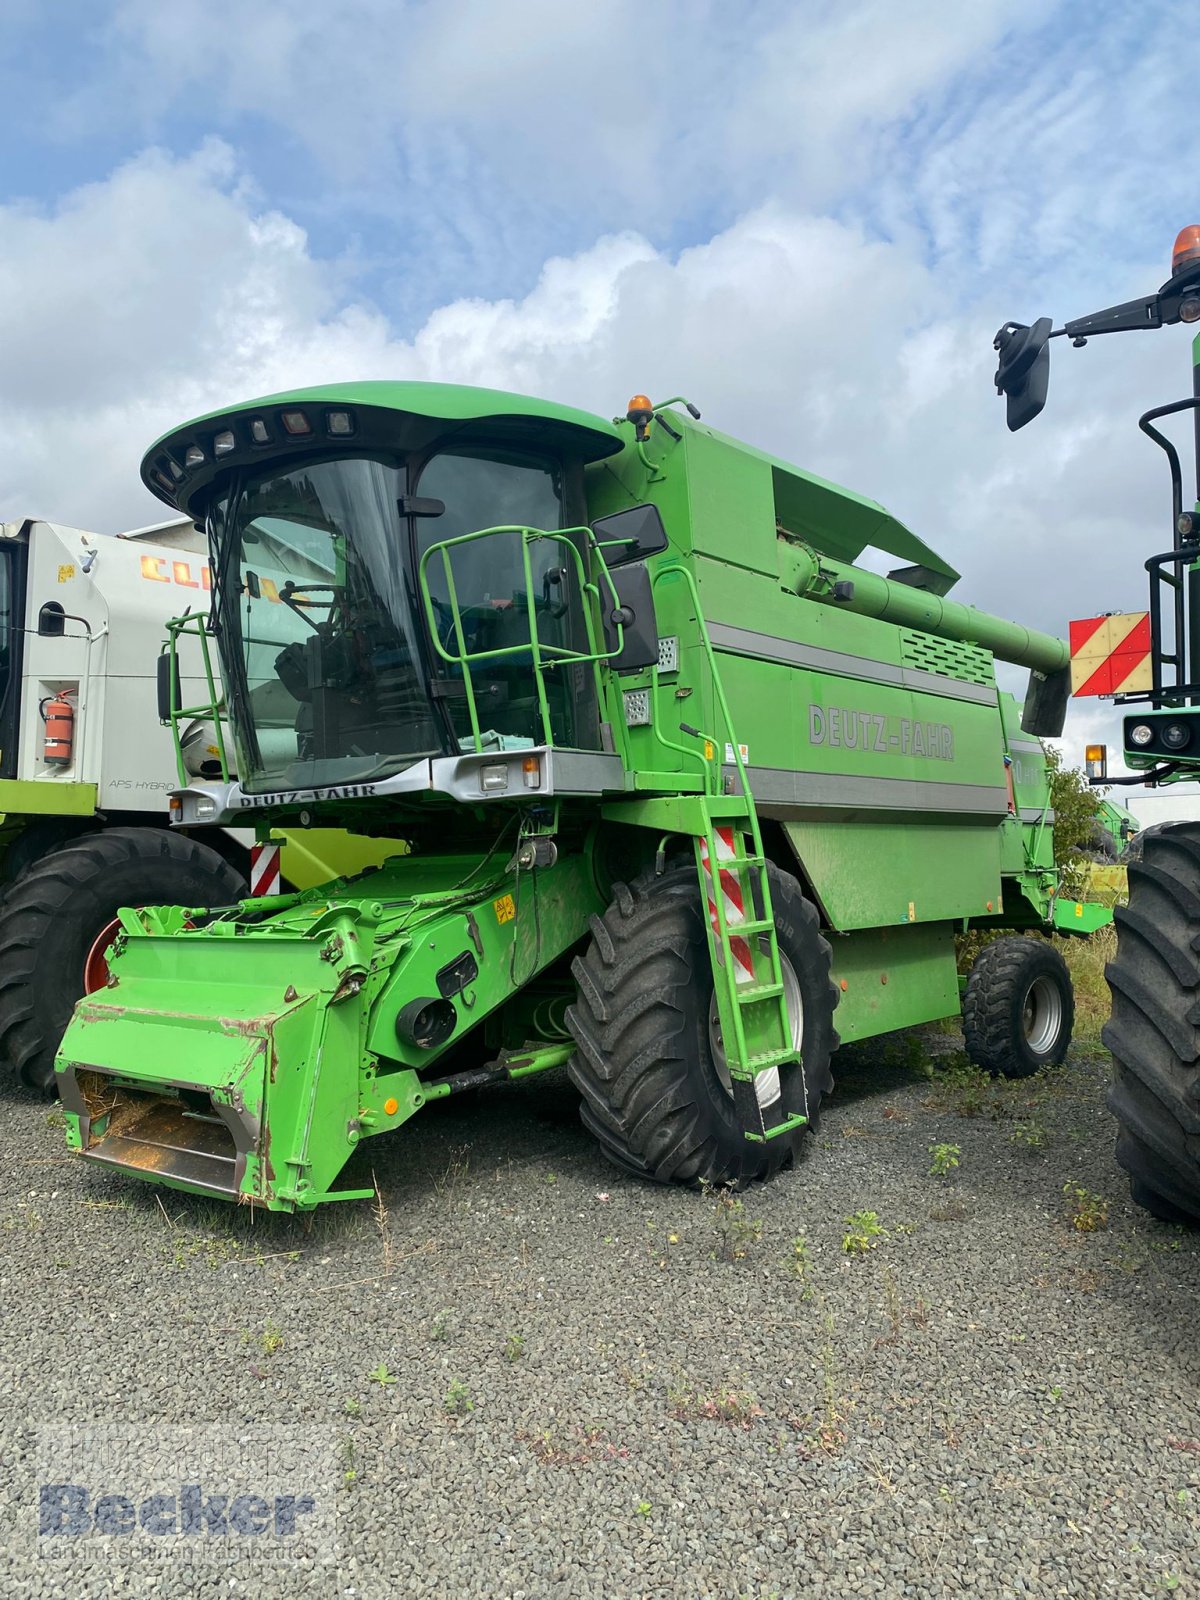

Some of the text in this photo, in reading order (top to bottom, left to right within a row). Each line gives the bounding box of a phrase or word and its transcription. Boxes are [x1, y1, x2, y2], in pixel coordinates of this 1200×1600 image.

[809, 704, 954, 762] DEUTZ-FAHR
[109, 780, 175, 791] APS HYBRID
[240, 784, 376, 807] DEUTZ-FAHR
